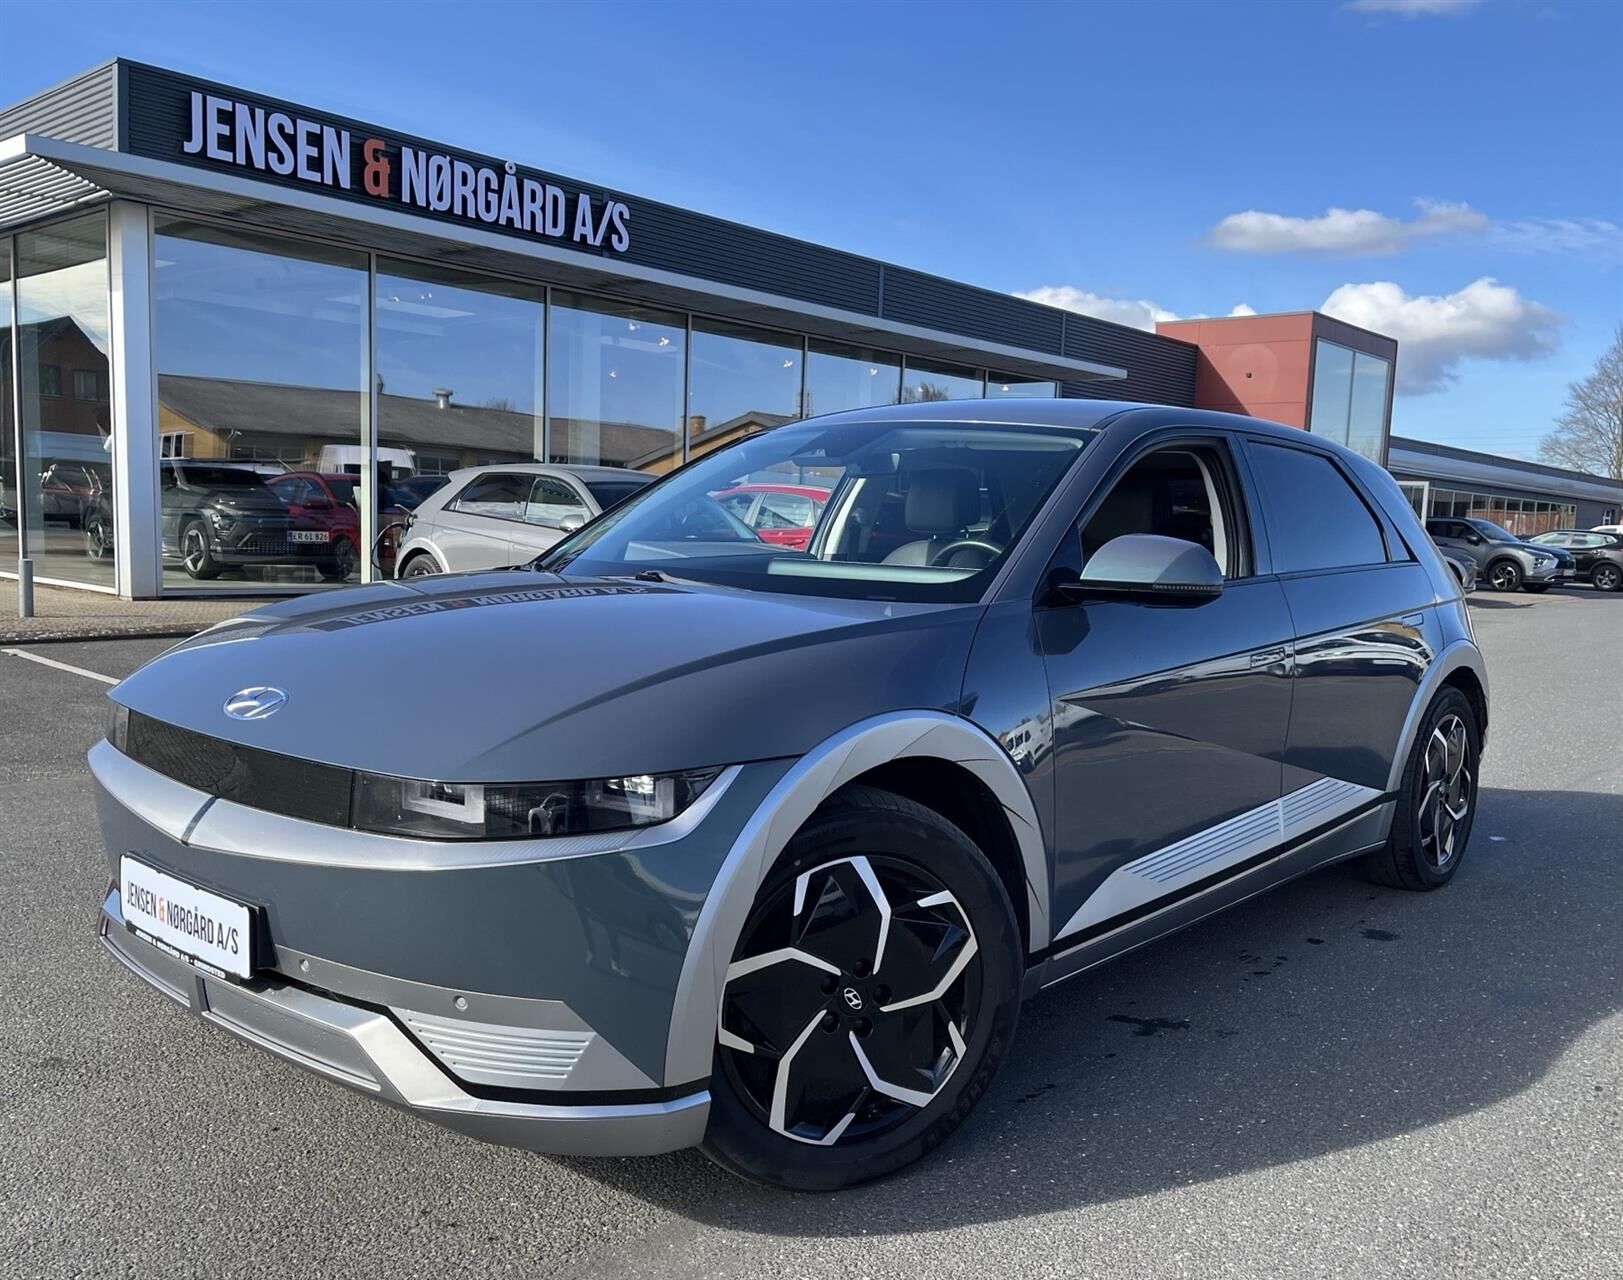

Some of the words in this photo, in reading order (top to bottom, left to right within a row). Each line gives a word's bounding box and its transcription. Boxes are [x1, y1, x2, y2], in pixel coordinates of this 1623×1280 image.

[184, 91, 350, 190] JENSEN
[364, 138, 390, 198] &
[401, 147, 566, 237] NØRGÅRD
[573, 192, 630, 252] A/S
[304, 533, 312, 541] 61
[127, 880, 157, 919] JENSEN
[159, 897, 165, 922] &
[167, 900, 214, 945] NØRGÅRD
[217, 923, 239, 954] A/S
